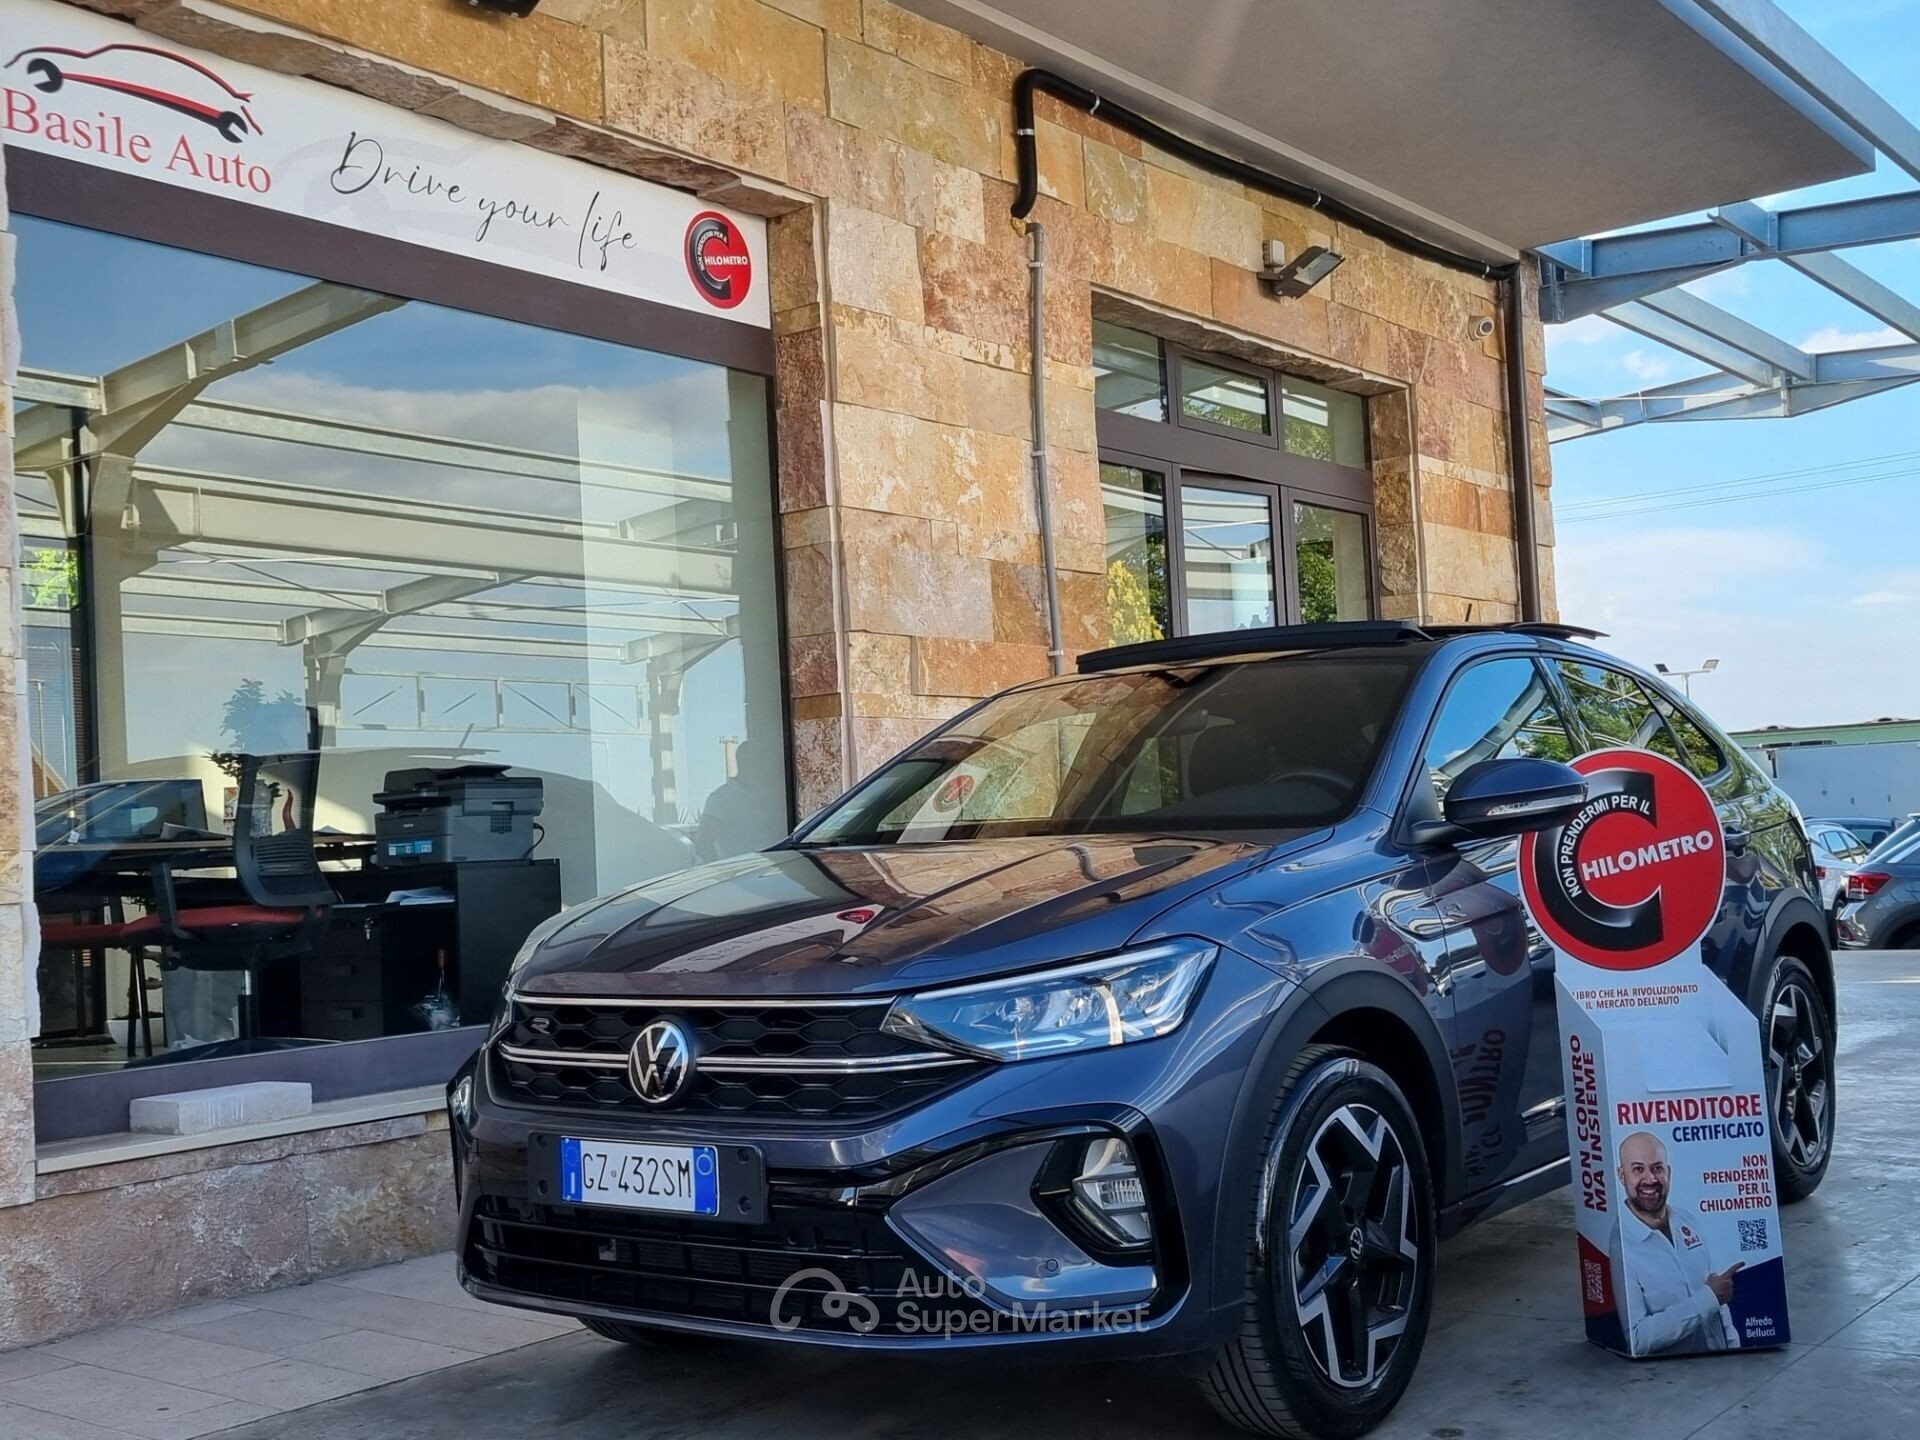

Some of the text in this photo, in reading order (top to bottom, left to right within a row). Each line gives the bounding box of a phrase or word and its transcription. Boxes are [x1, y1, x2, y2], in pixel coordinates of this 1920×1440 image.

[1, 87, 272, 194] Basile Auto
[330, 131, 638, 271] Drive your life
[1561, 795, 1650, 898] NON PRENDERMI PER IL
[1572, 984, 1698, 1000] IBRO CHE HA RIVOLUZIONATO
[1596, 998, 1635, 1009] MERCATO
[1637, 995, 1680, 1007] DELL'AUTO
[1617, 1094, 1762, 1125] RIVENDITORE
[1570, 1034, 1595, 1210] NON CONTRO
[1672, 1121, 1764, 1143] CERTIFICATO
[1583, 1052, 1607, 1213] MA INSIEME
[1743, 1154, 1768, 1168] NON
[1703, 1168, 1769, 1185] PRENDERMI
[1738, 1182, 1772, 1196] PER IL
[1699, 1195, 1772, 1213] CHILOMETRO
[1745, 1315, 1774, 1328] Alfredo
